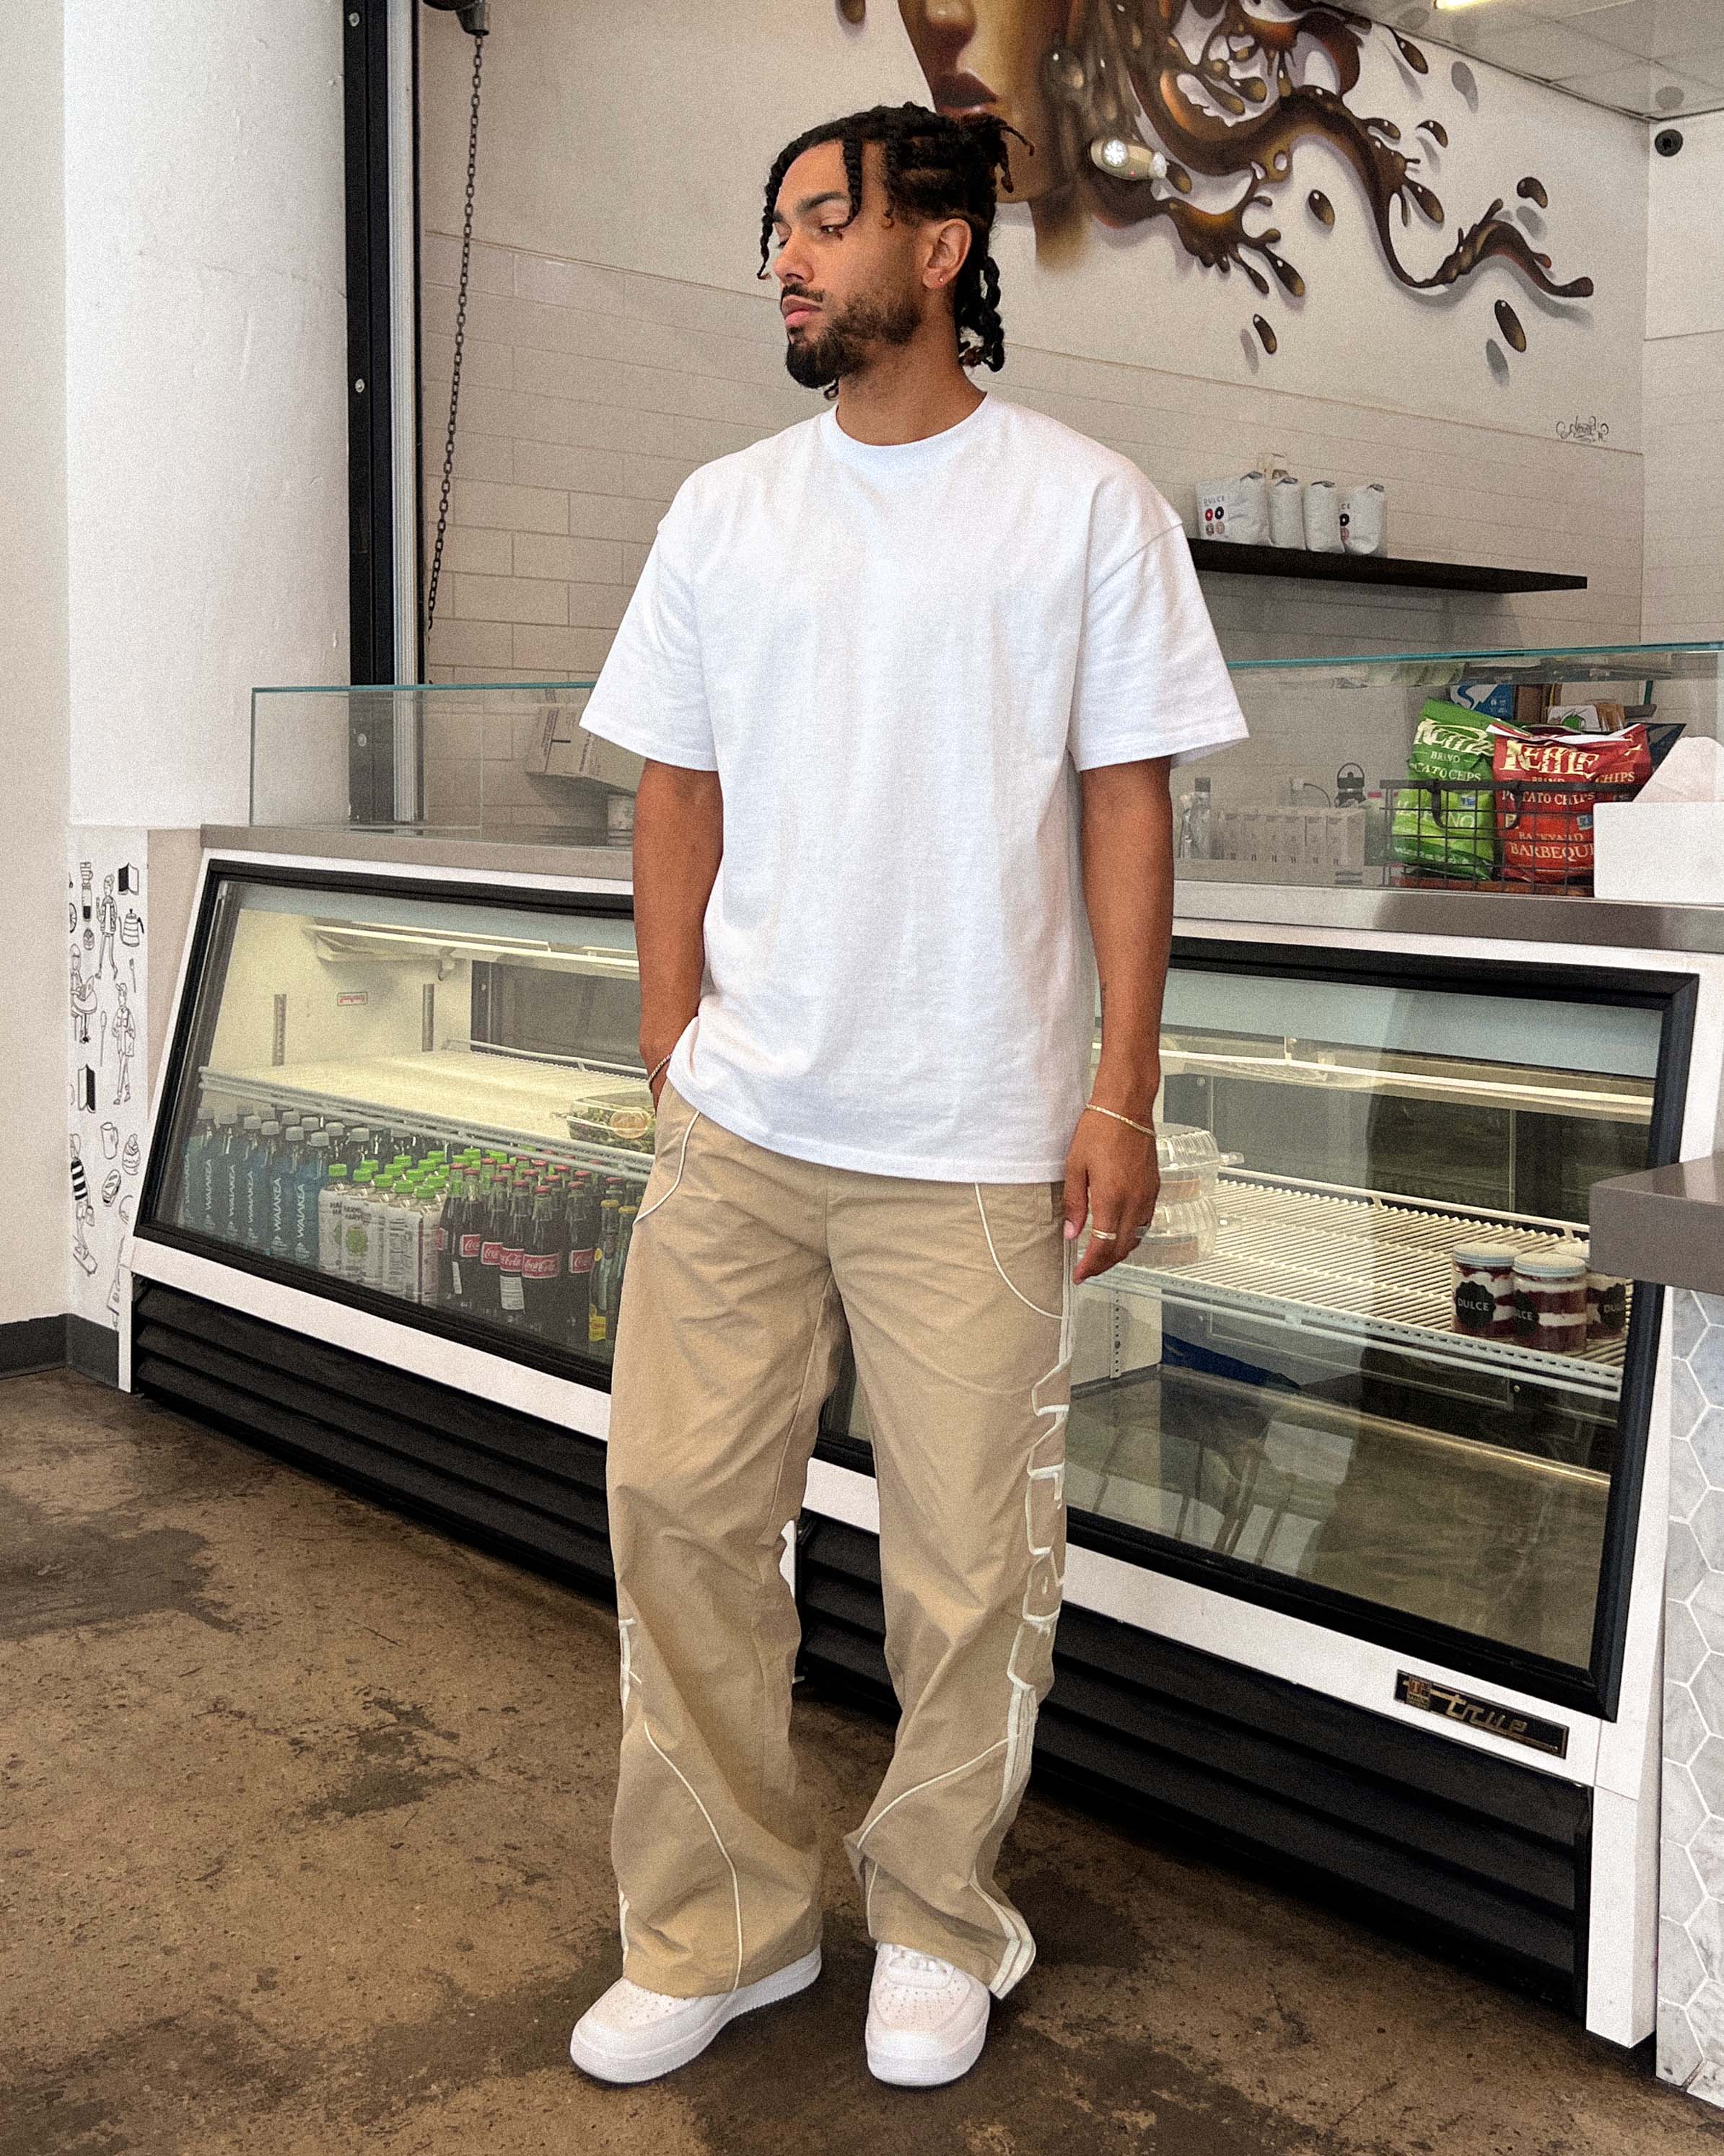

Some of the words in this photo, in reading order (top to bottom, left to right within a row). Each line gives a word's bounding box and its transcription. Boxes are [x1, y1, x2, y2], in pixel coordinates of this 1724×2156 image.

[1203, 496, 1225, 505] DULCE
[1554, 793, 1596, 806] CHIPS
[1518, 831, 1584, 841] BAKYARD
[272, 1177, 282, 1232] WAIAKEA
[296, 1183, 305, 1239] WAIAKEA
[1458, 1298, 1489, 1312] DULCE
